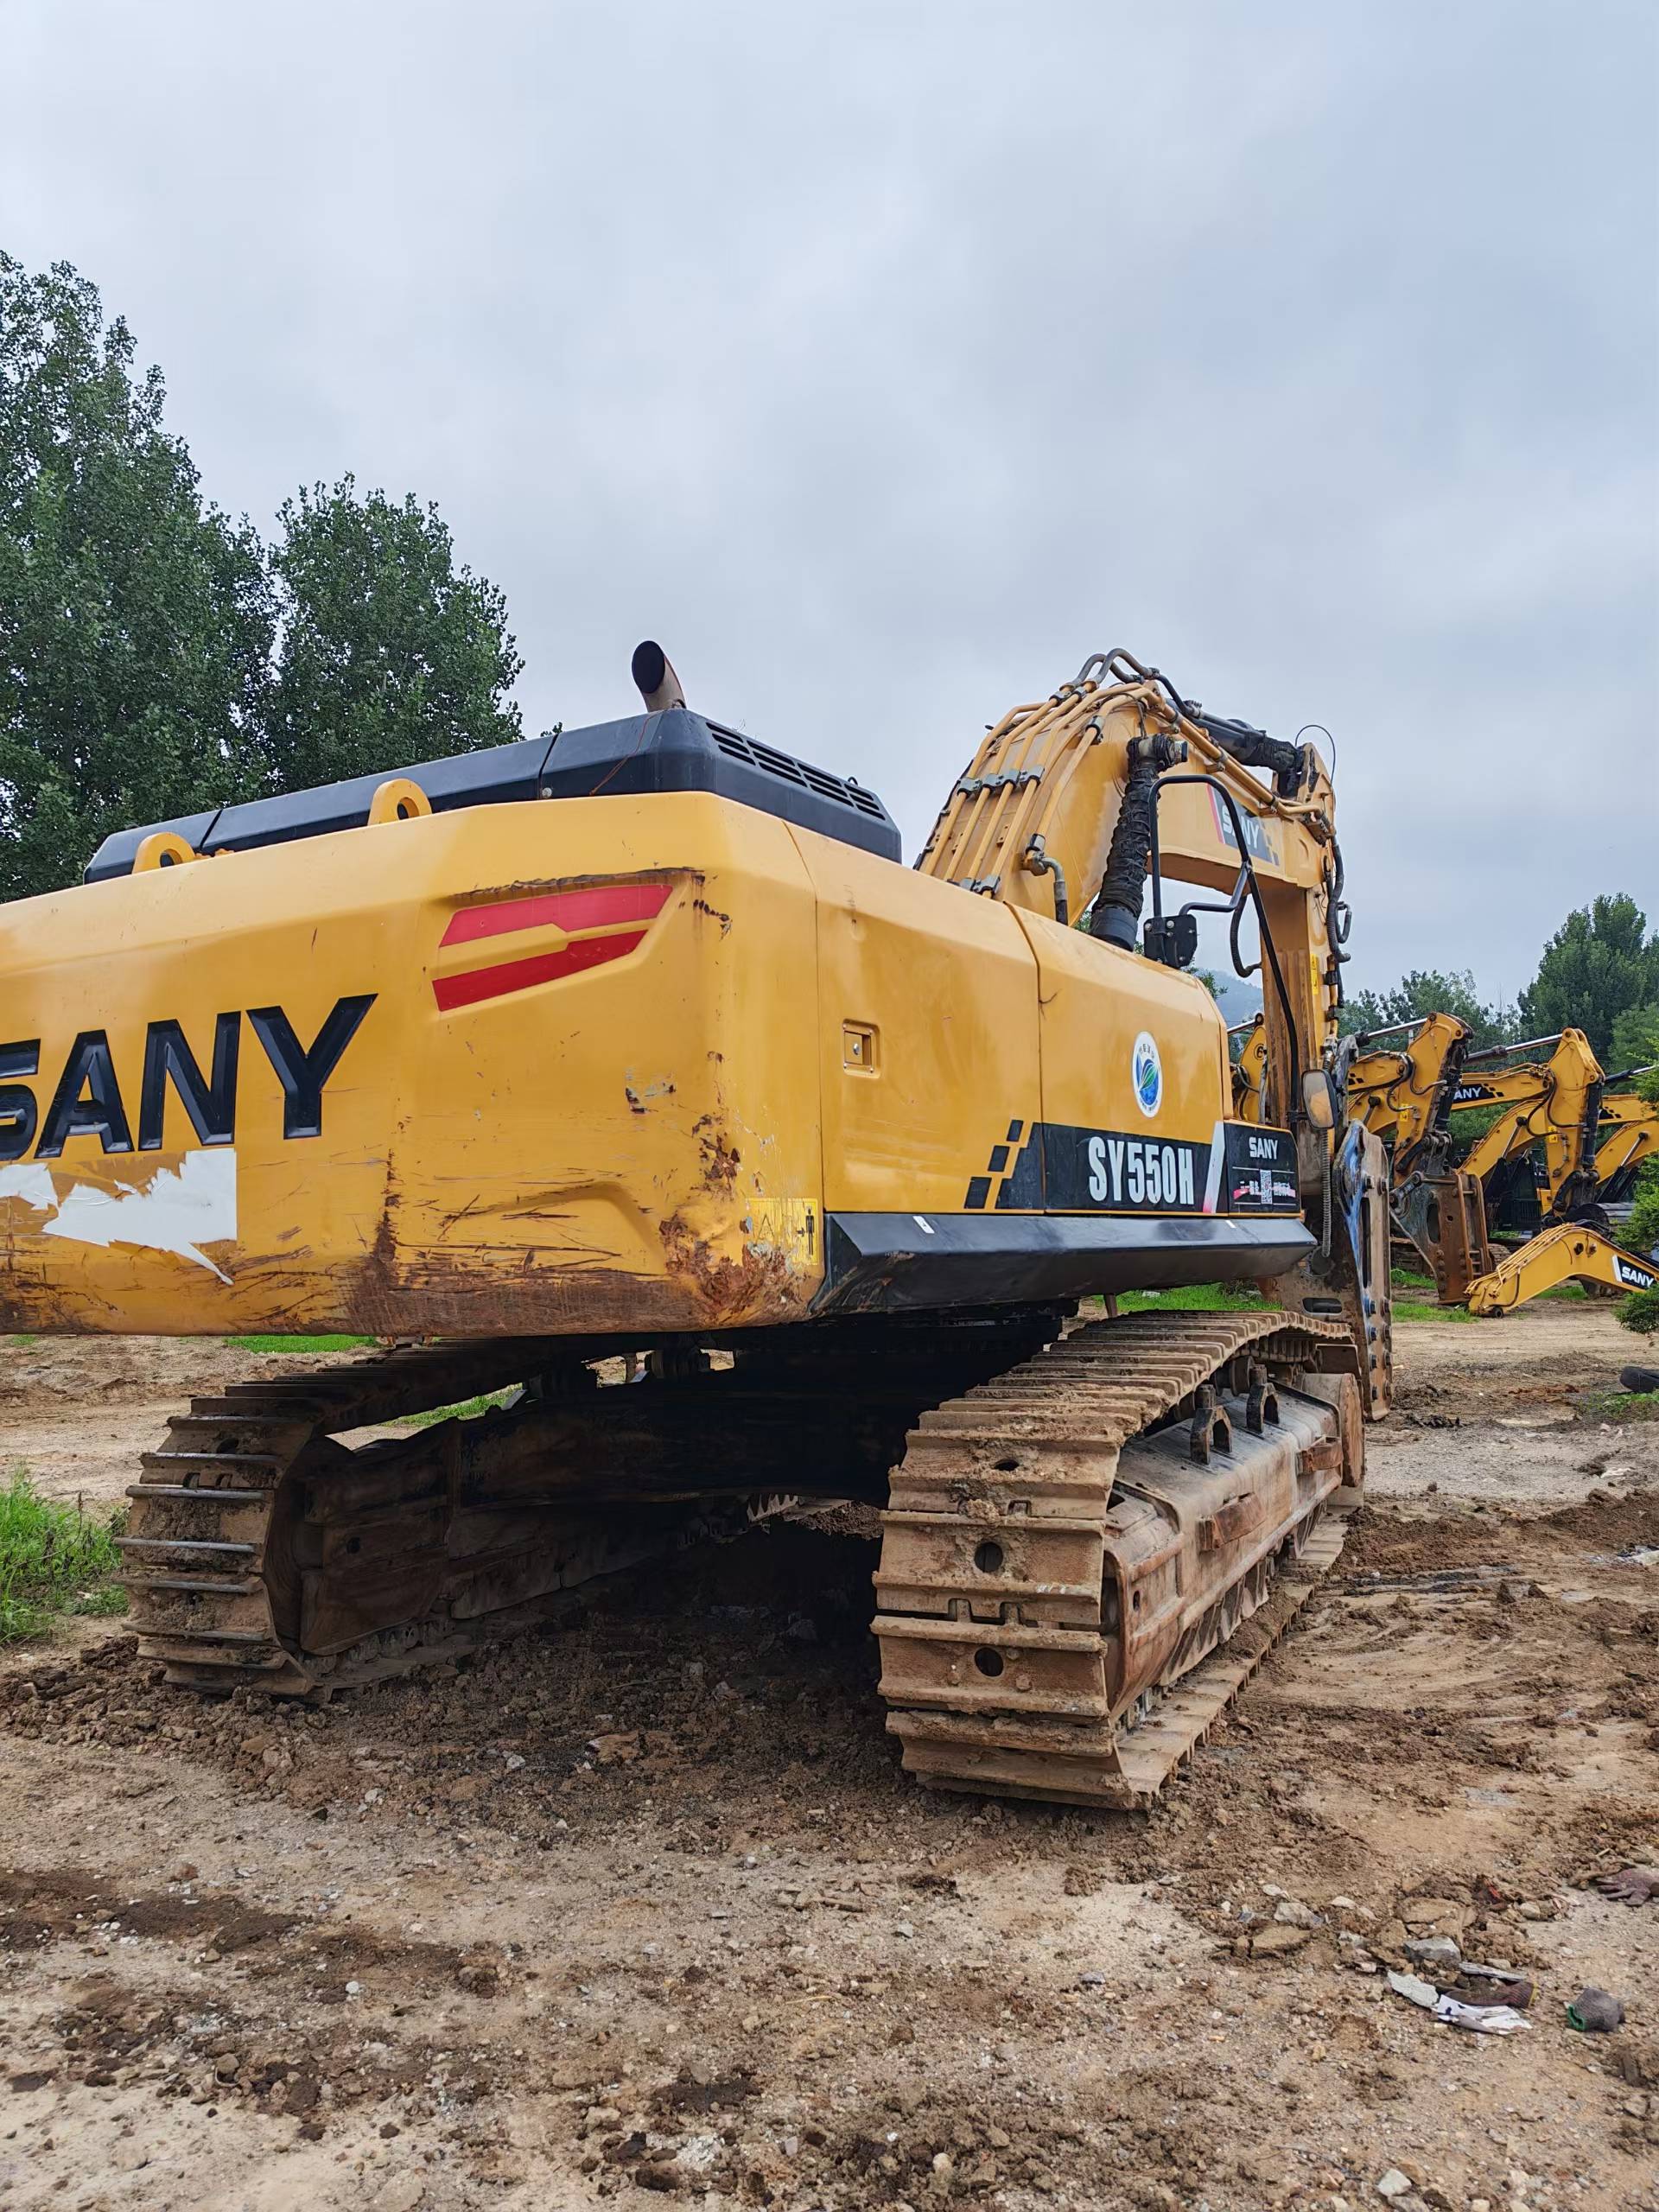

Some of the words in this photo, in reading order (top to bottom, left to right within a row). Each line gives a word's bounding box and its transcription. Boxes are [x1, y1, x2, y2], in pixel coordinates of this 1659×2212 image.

[1222, 804, 1260, 849] SNY
[1453, 1087, 1482, 1100] ANY
[1249, 1136, 1278, 1160] SANY
[1089, 1136, 1194, 1205] SY550H
[1622, 1266, 1654, 1287] SANY
